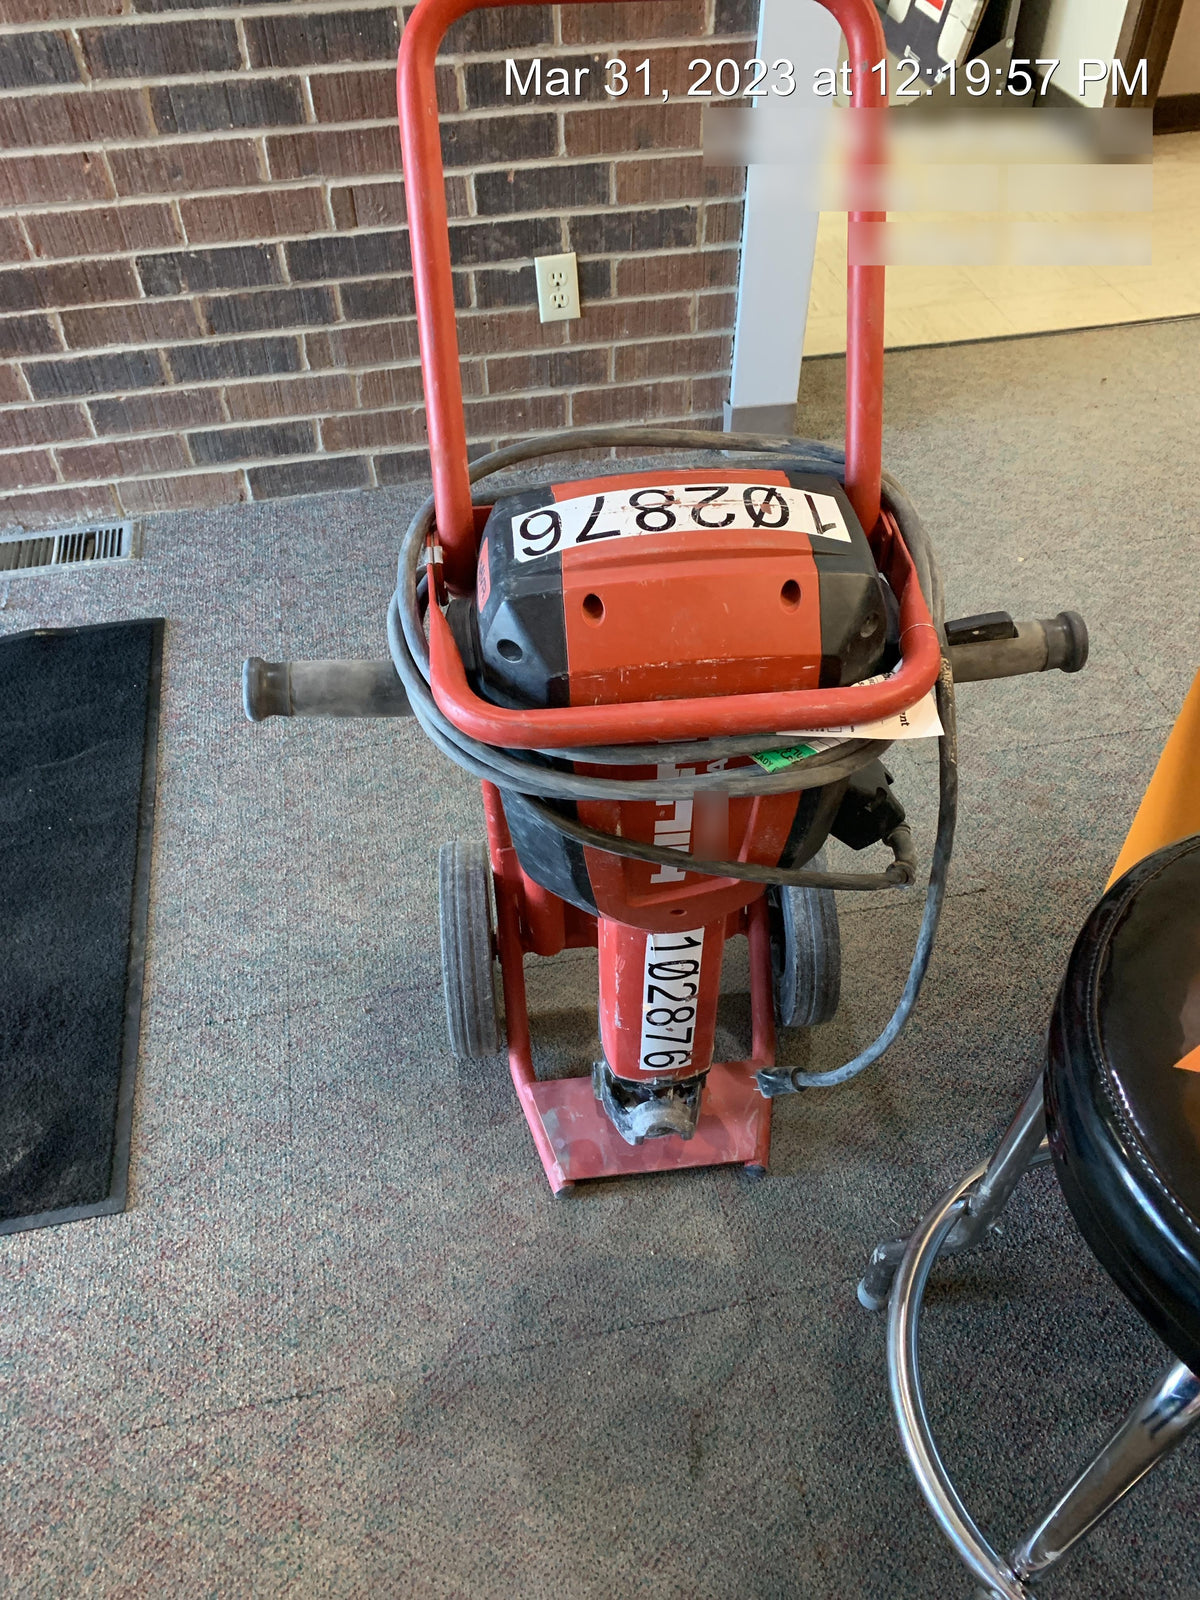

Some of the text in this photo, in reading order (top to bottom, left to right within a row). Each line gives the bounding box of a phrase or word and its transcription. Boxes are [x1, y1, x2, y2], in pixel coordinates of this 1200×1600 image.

[518, 485, 838, 557] 102876
[650, 738, 698, 884] HIL
[643, 936, 702, 1069] 102876
